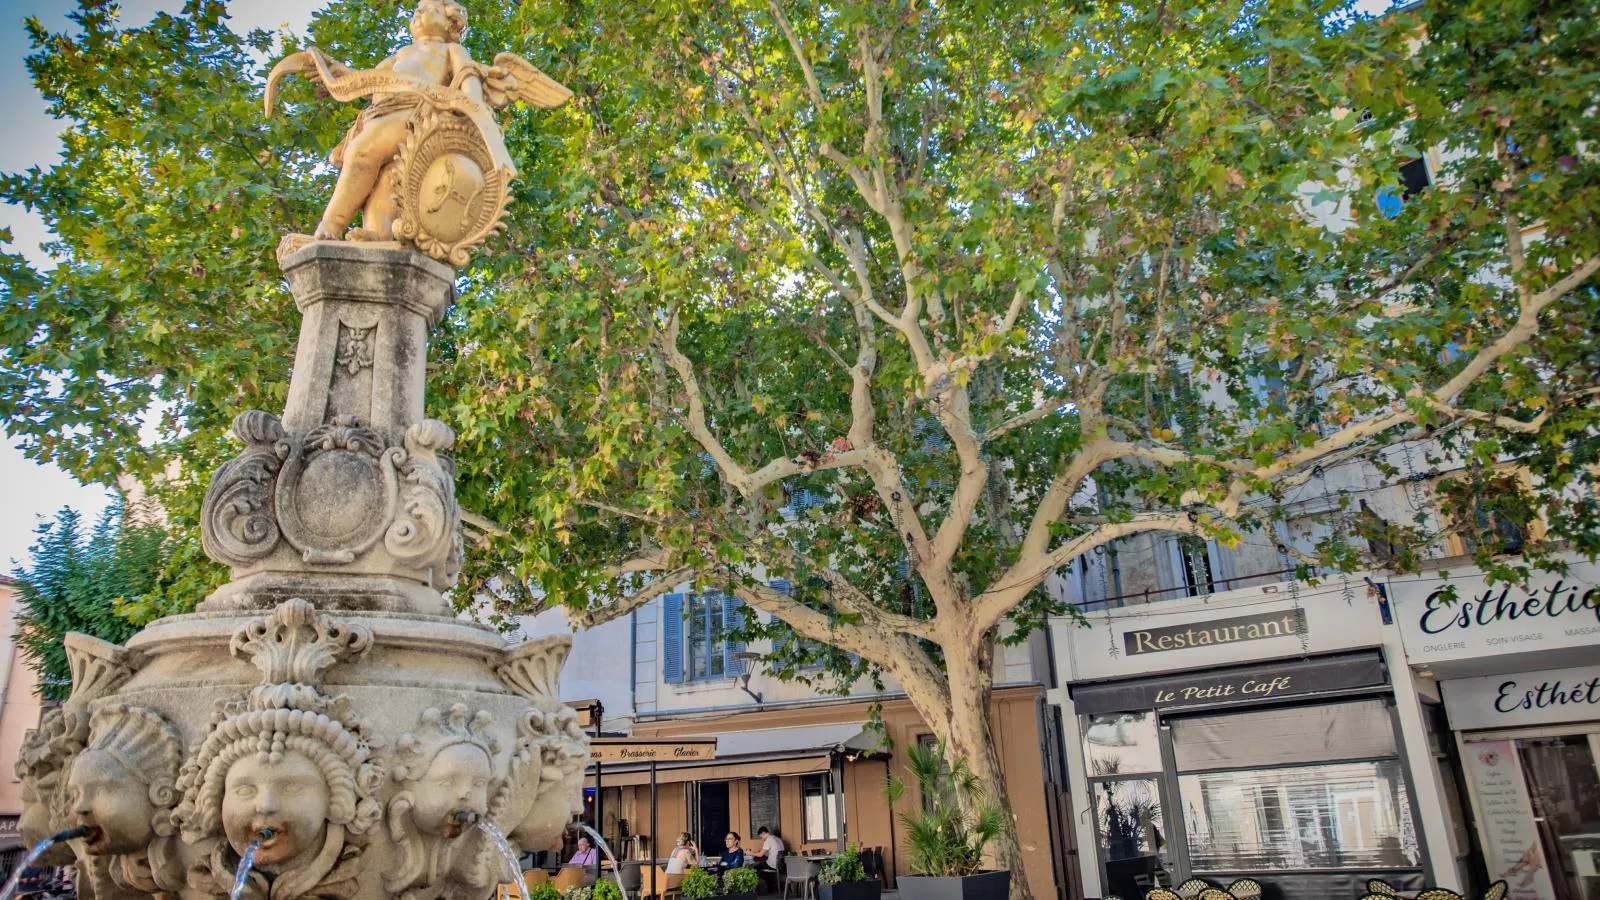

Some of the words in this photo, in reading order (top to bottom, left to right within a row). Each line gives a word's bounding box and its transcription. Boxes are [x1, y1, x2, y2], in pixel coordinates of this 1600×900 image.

[1134, 615, 1297, 654] Restaurant
[1423, 641, 1467, 653] ONGLERIE
[1485, 636, 1509, 646] SOIN
[1510, 632, 1544, 643] VISAGE
[1154, 690, 1176, 703] Le
[1179, 684, 1236, 700] Petit
[1241, 676, 1292, 697] Café
[620, 748, 656, 759] Brasserie
[674, 746, 699, 757] Glacier
